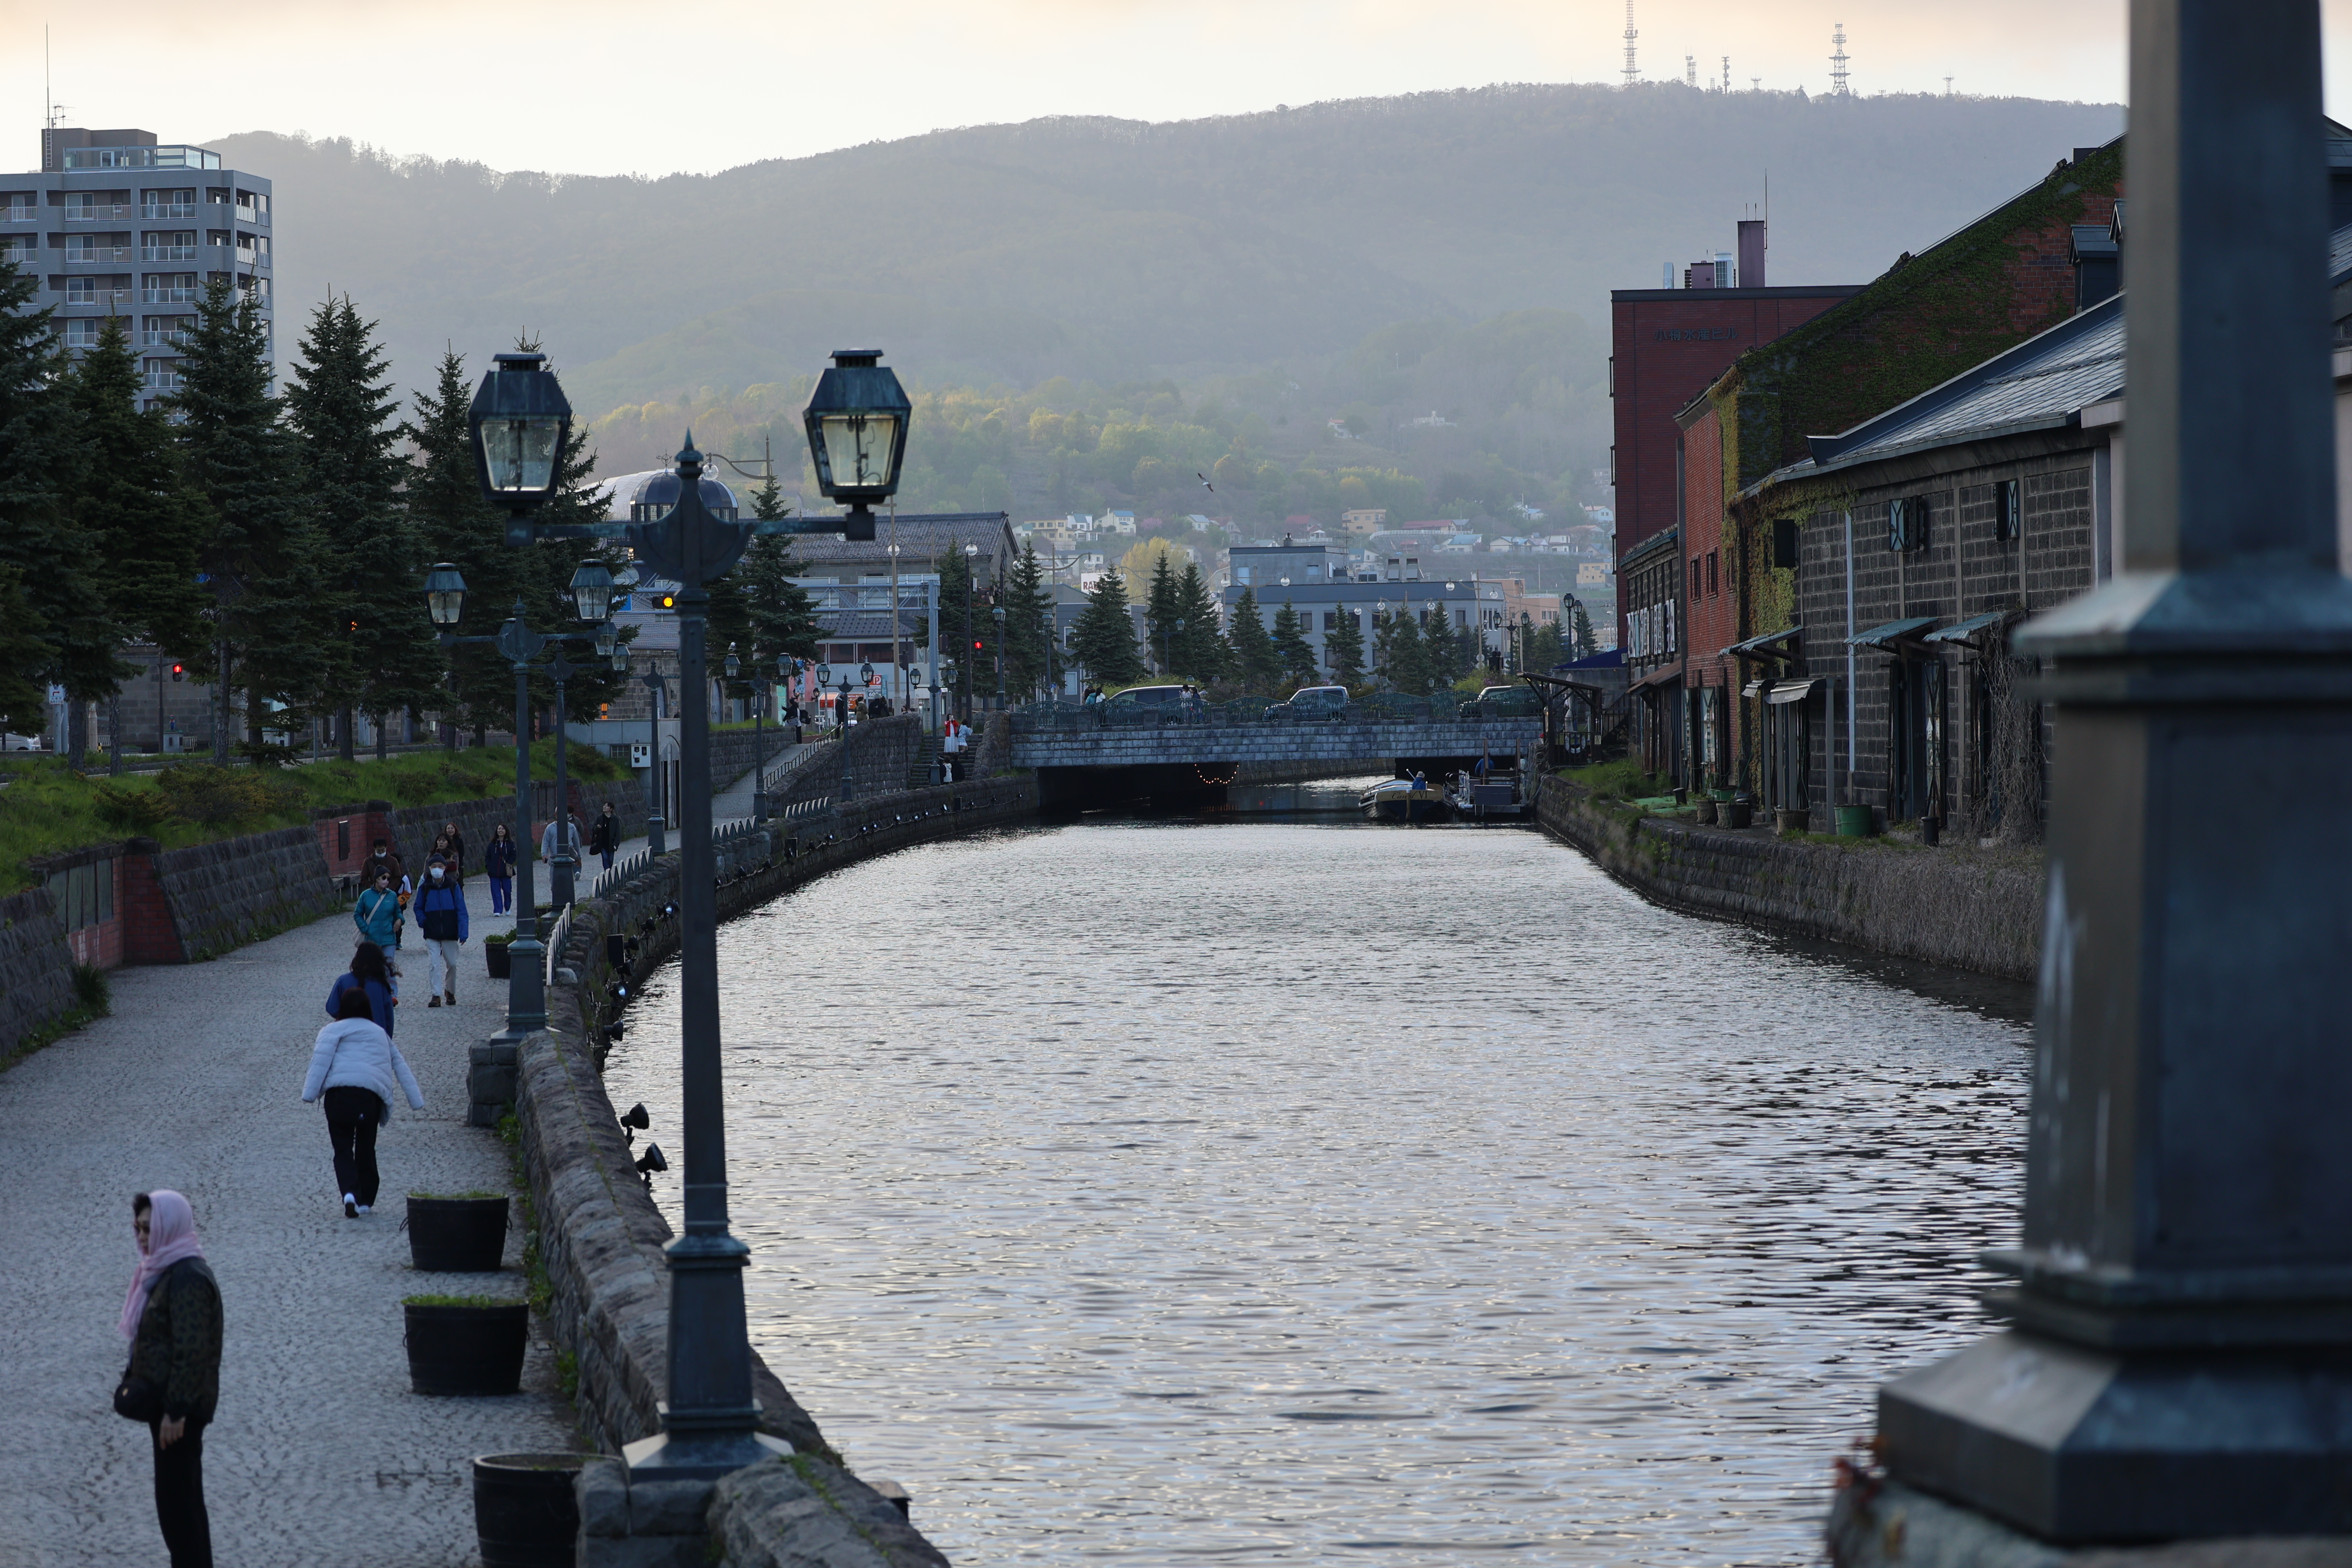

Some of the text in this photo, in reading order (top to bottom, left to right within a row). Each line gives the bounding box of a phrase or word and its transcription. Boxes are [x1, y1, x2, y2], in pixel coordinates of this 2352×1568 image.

[1654, 327, 1738, 341] 小樽水産ビル
[1392, 791, 1417, 799] Canl
